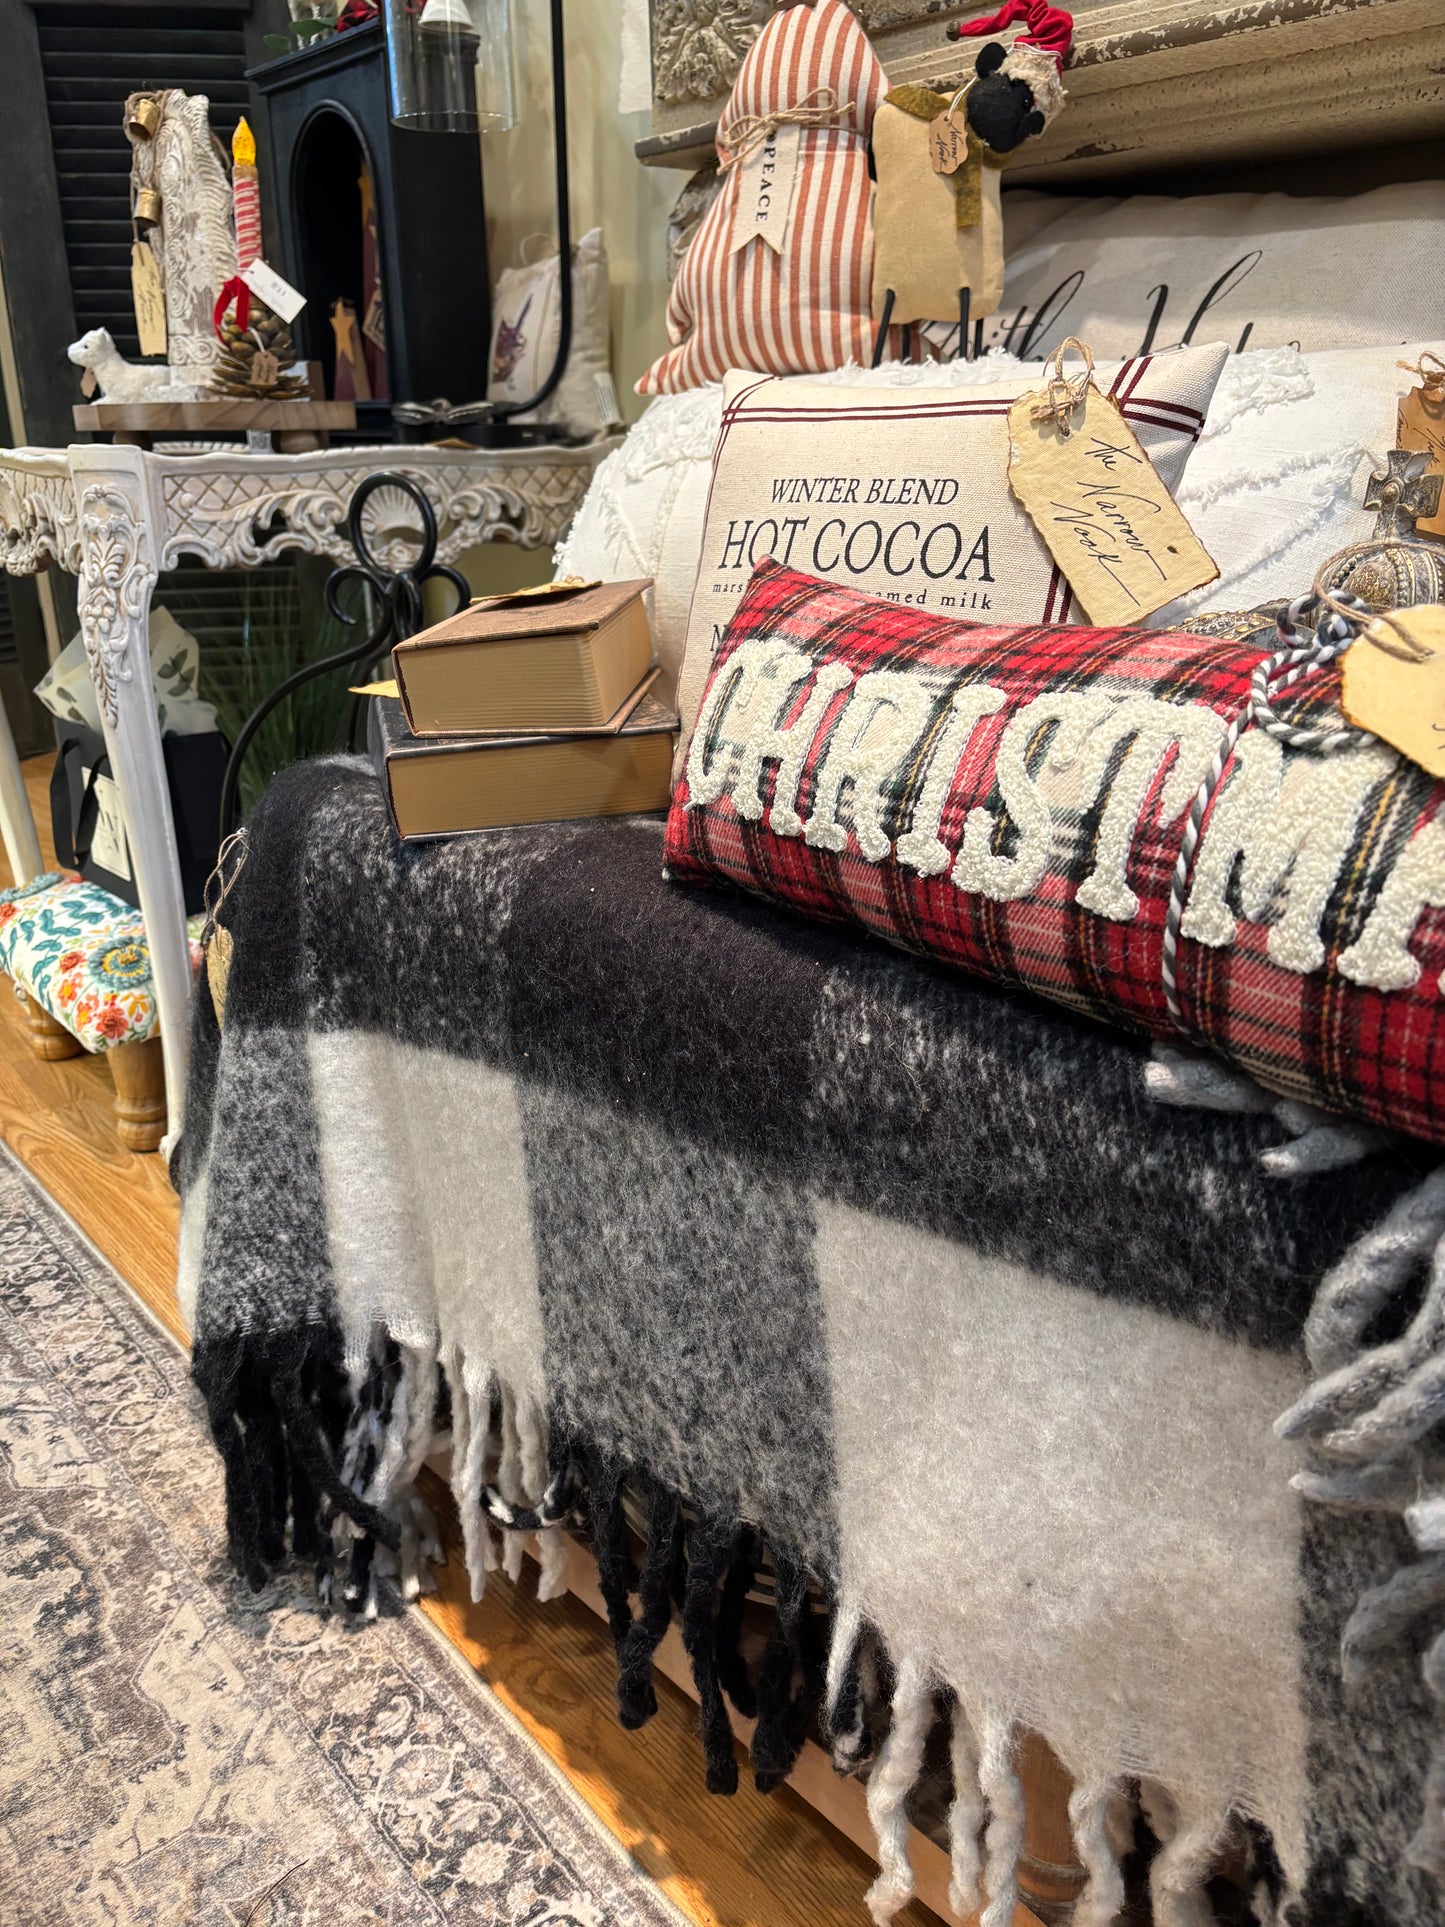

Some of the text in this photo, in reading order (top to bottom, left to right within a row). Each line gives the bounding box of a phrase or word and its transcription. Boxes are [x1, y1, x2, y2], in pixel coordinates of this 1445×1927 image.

[755, 146, 777, 222] PEACE
[1084, 437, 1143, 471] The
[771, 477, 960, 506] WINTER BLEND
[718, 516, 996, 583] HOT COCOA
[1050, 501, 1141, 606] Nook
[1076, 481, 1167, 581] Narrow
[940, 592, 992, 610] milk
